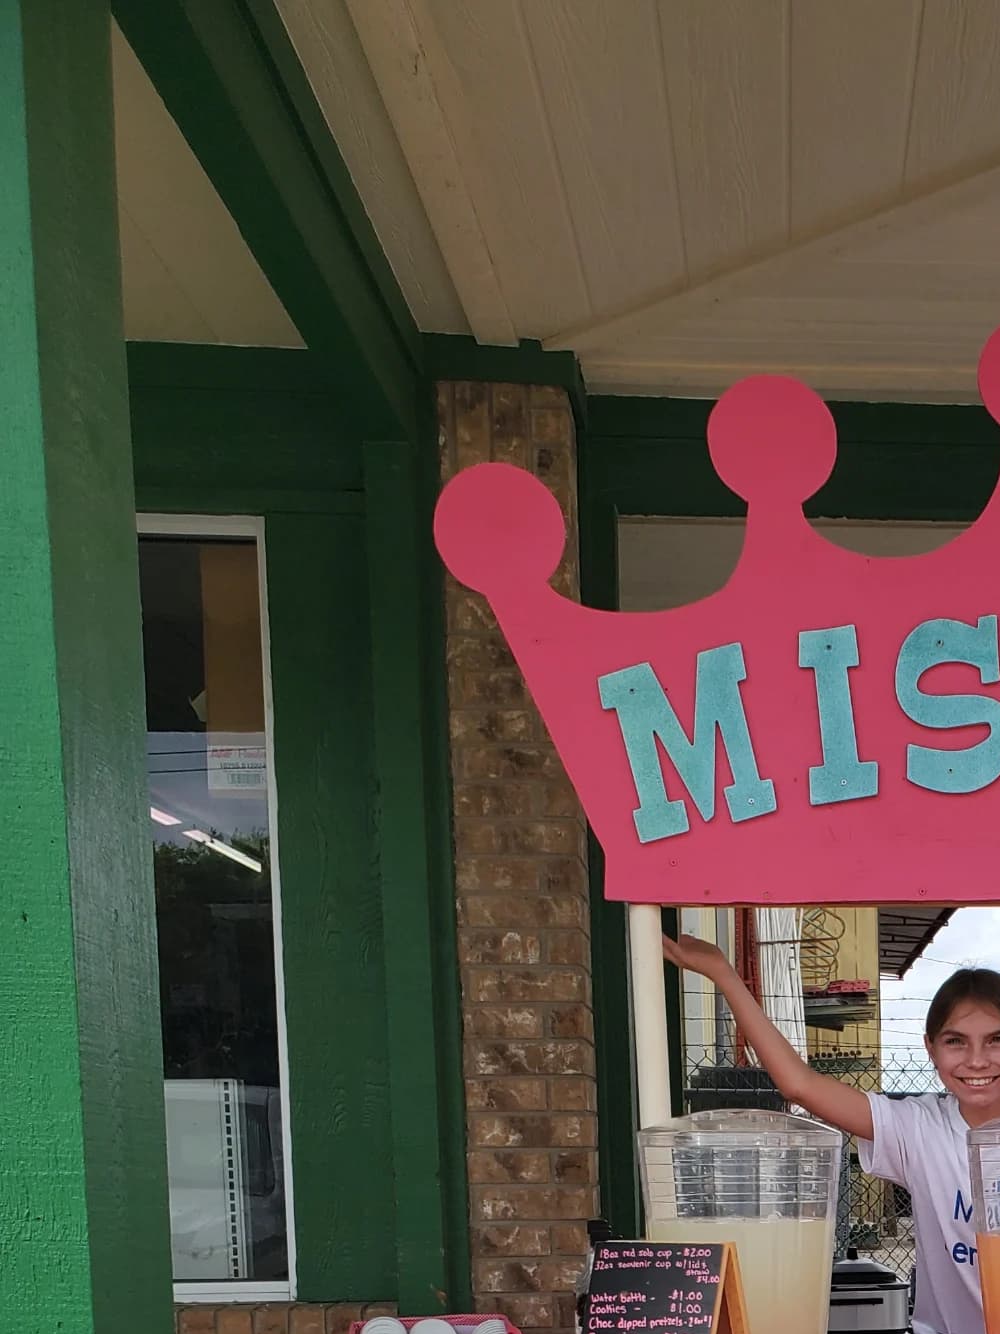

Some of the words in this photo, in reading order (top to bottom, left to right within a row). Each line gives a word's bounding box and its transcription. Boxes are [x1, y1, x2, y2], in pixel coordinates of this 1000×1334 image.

[623, 1248, 635, 1257] red
[657, 1250, 672, 1259] cup
[684, 1248, 711, 1257] $2.00
[618, 1260, 651, 1268] souvenir
[655, 1261, 671, 1269] cup
[696, 1276, 720, 1284] $4.00
[591, 1292, 617, 1303] Water
[620, 1292, 646, 1303] bottle
[590, 1304, 627, 1314] Cookies
[671, 1303, 701, 1313] $1.00
[618, 1316, 646, 1329] dipped
